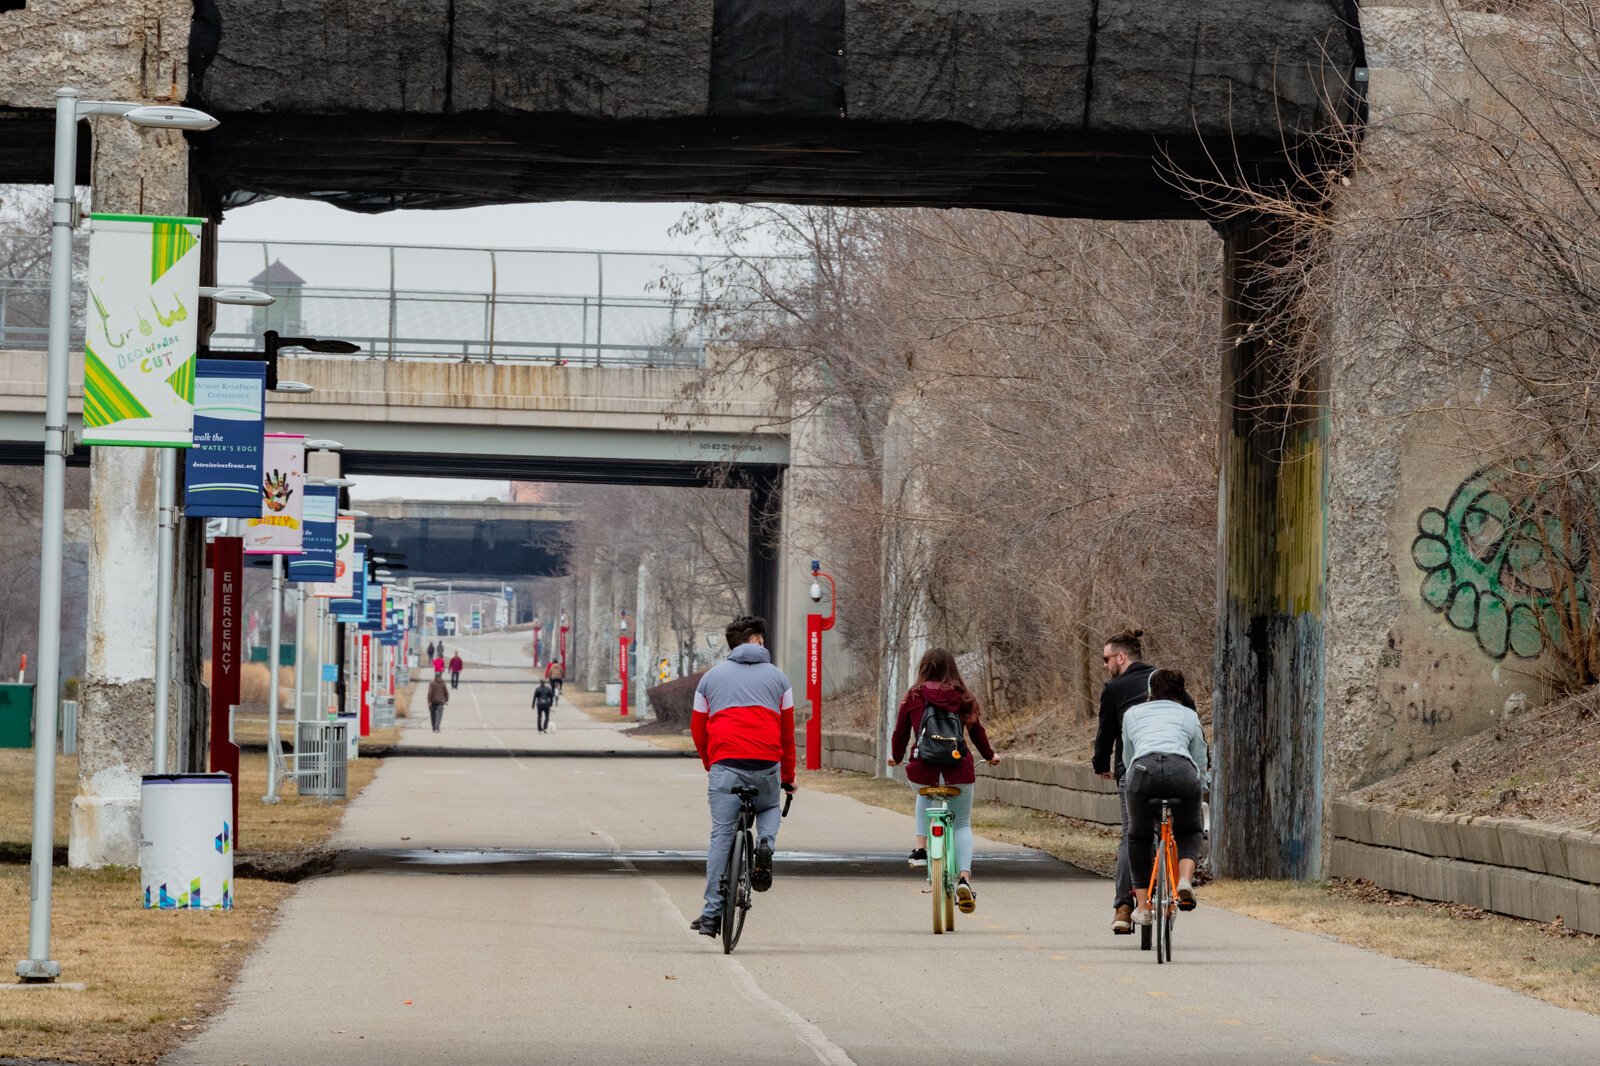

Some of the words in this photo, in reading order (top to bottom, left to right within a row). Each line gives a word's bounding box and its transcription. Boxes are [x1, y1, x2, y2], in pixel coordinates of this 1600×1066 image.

[140, 351, 173, 373] CUT
[193, 432, 212, 442] walk
[212, 433, 224, 442] the
[201, 444, 234, 452] WATER'S
[192, 462, 257, 471] detroitriverfront.org
[222, 571, 233, 675] EMERGENCY
